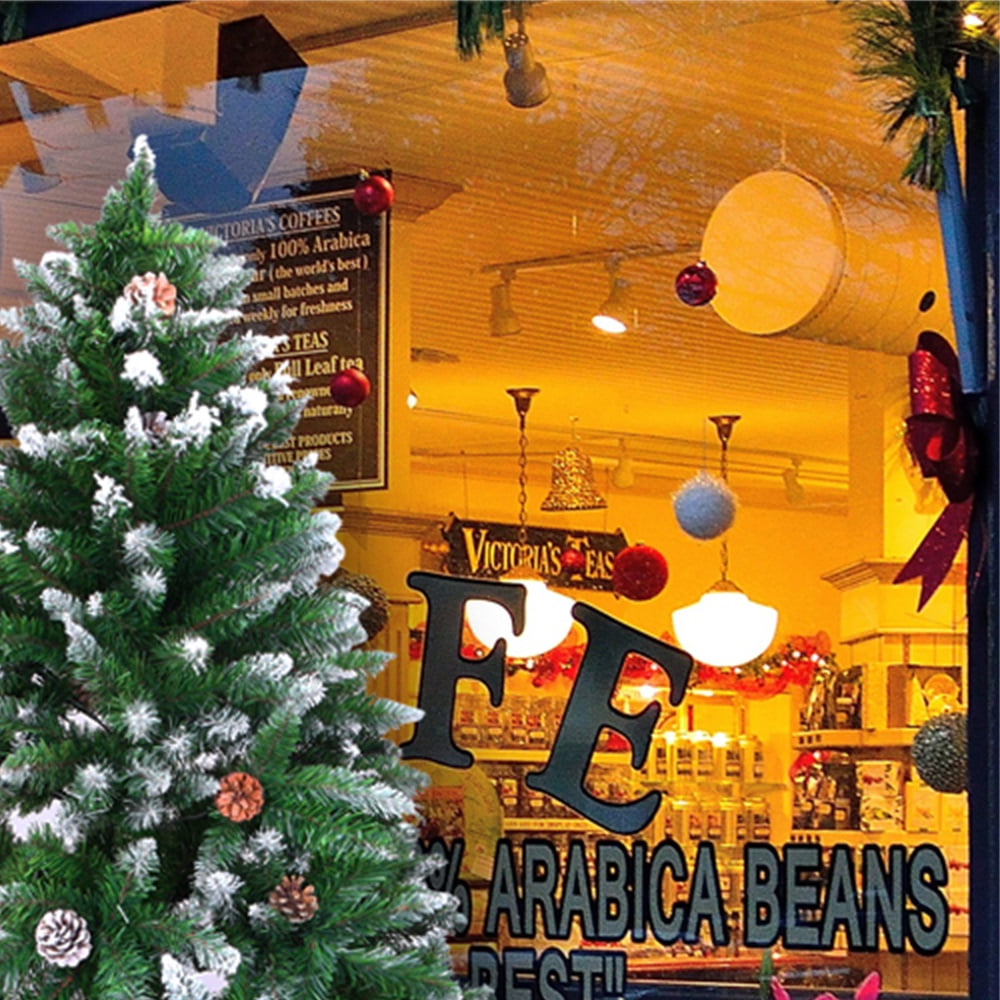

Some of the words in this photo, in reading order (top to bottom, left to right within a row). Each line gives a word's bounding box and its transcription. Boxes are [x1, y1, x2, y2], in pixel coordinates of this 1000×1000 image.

[279, 205, 341, 231] COFFEES
[270, 238, 310, 259] 100%
[312, 230, 371, 253] Arabica
[295, 257, 336, 277] world's
[337, 254, 369, 272] best)
[327, 277, 349, 293] and
[281, 303, 298, 319] for
[300, 298, 353, 317] freshness
[292, 330, 329, 351] TEAS
[274, 358, 301, 377] Fll
[304, 355, 338, 377] Leaf
[340, 356, 364, 373] tea
[298, 430, 353, 447] PRODUCTS
[462, 527, 562, 576] VICTORIA'S
[484, 837, 730, 948] ARABICA
[743, 842, 950, 956] BEANS
